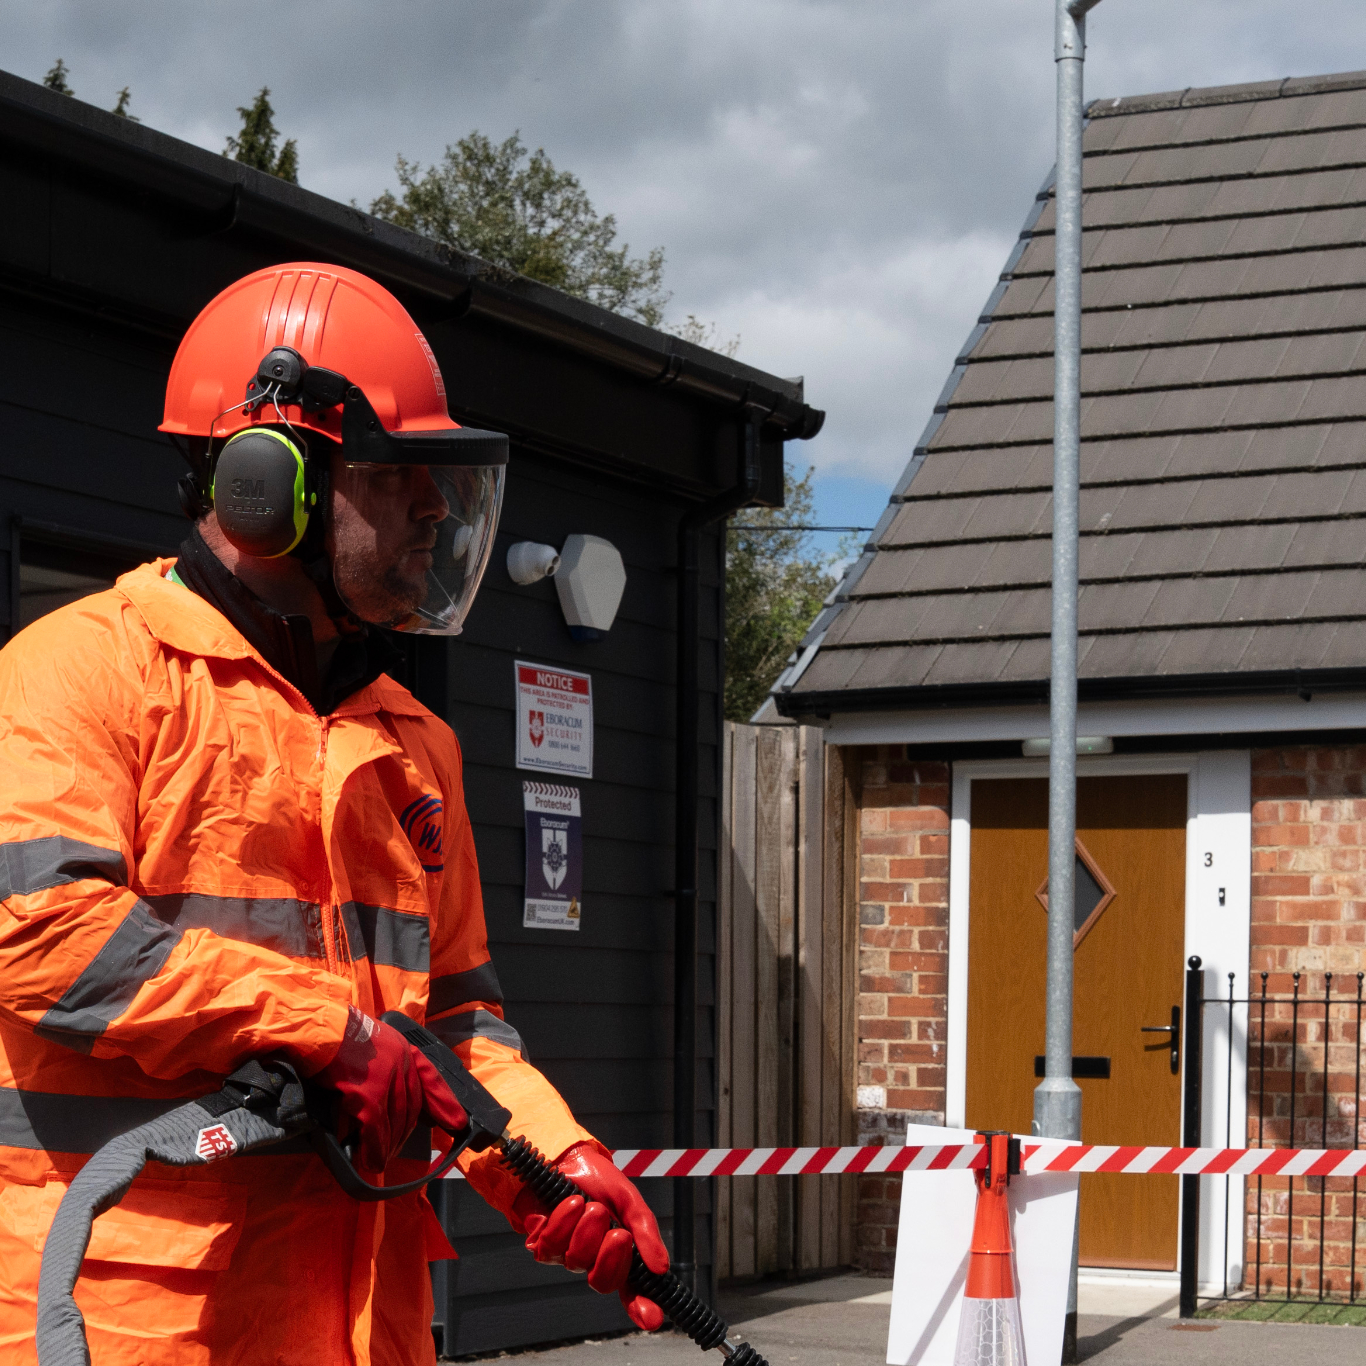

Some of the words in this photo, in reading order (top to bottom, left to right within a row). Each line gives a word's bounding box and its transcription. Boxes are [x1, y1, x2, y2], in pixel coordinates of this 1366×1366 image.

[231, 479, 265, 500] 3M
[536, 672, 573, 691] NOTICE
[520, 686, 531, 694] THIS
[537, 698, 565, 709] PROTECTED
[546, 713, 583, 728] EBORACUM
[546, 727, 582, 741] SECURITY
[535, 797, 571, 811] Protected
[1203, 852, 1213, 867] 3
